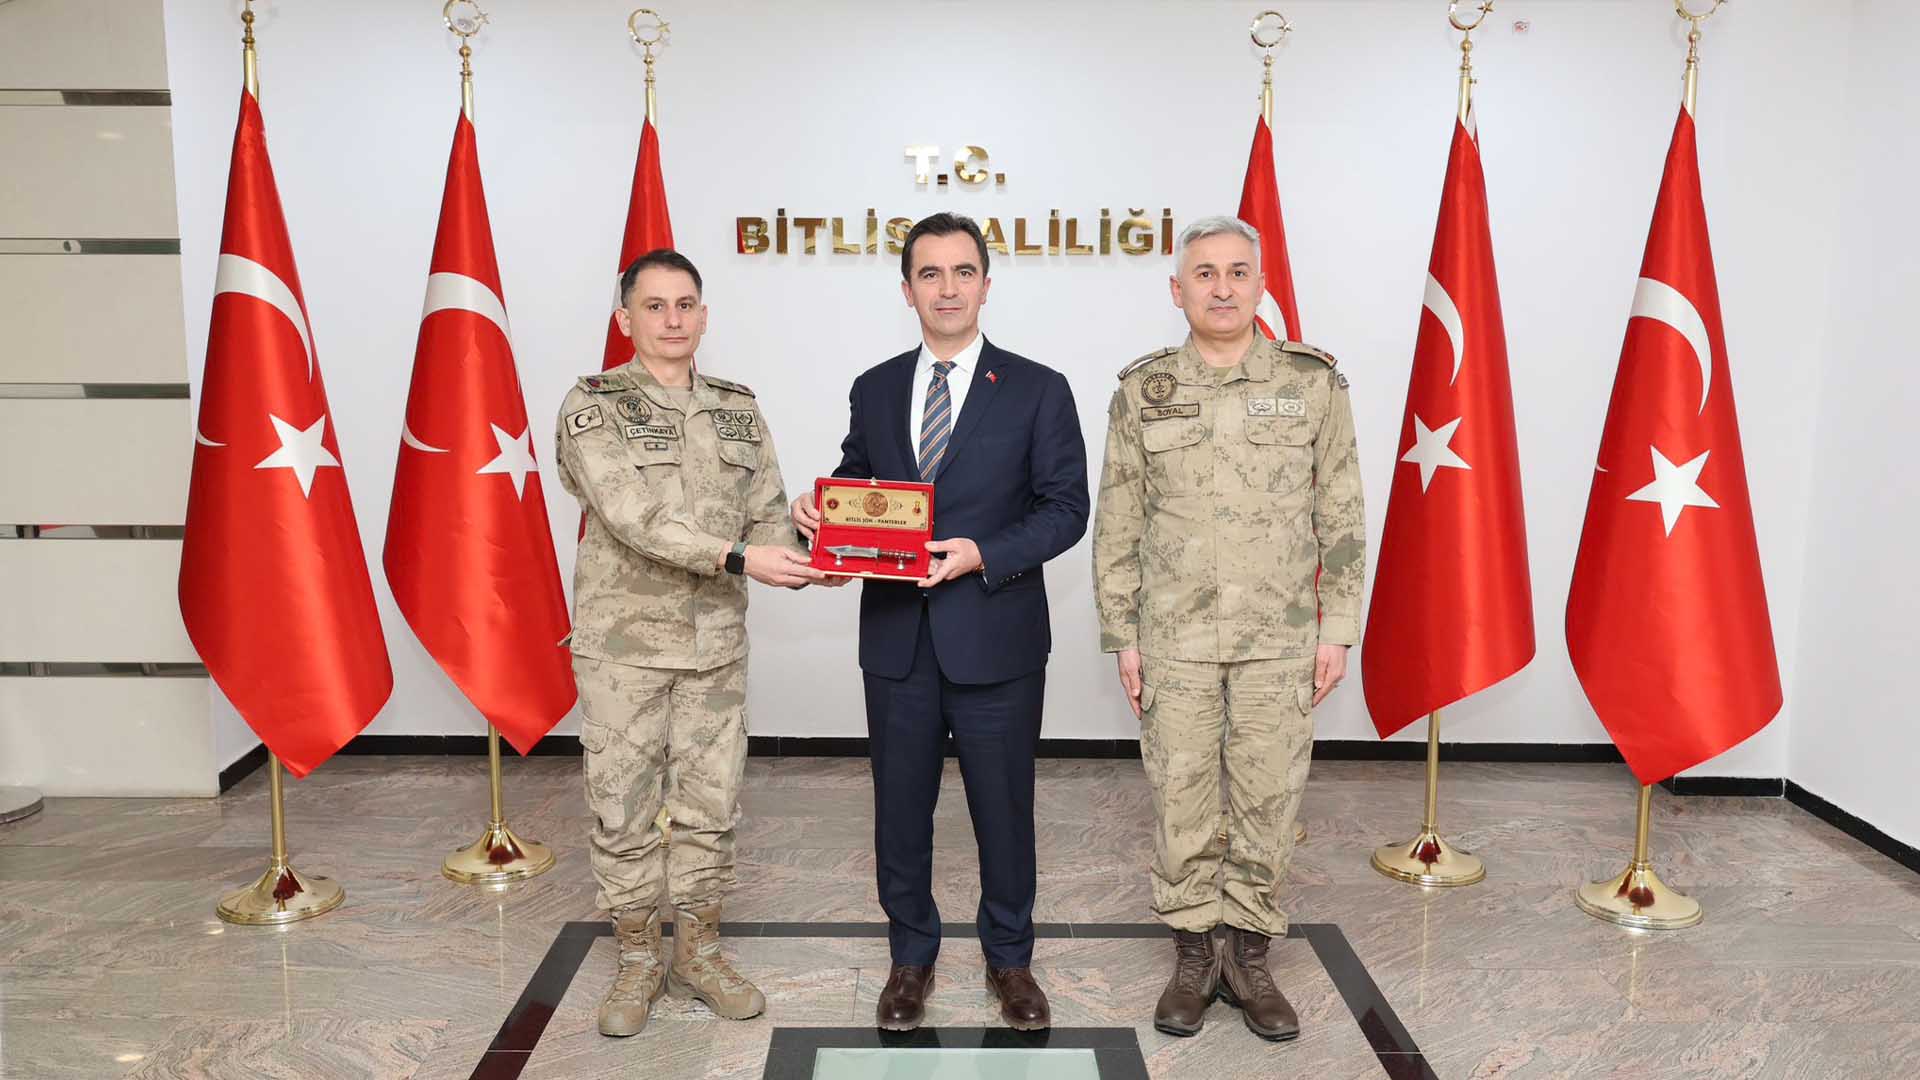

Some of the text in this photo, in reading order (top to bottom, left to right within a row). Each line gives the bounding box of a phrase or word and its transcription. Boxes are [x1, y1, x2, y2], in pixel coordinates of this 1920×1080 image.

[904, 145, 1006, 185] T.C.
[737, 208, 1173, 255] BİTLİS ALİLİĞİ
[630, 426, 674, 436] ÇETİNKAYA
